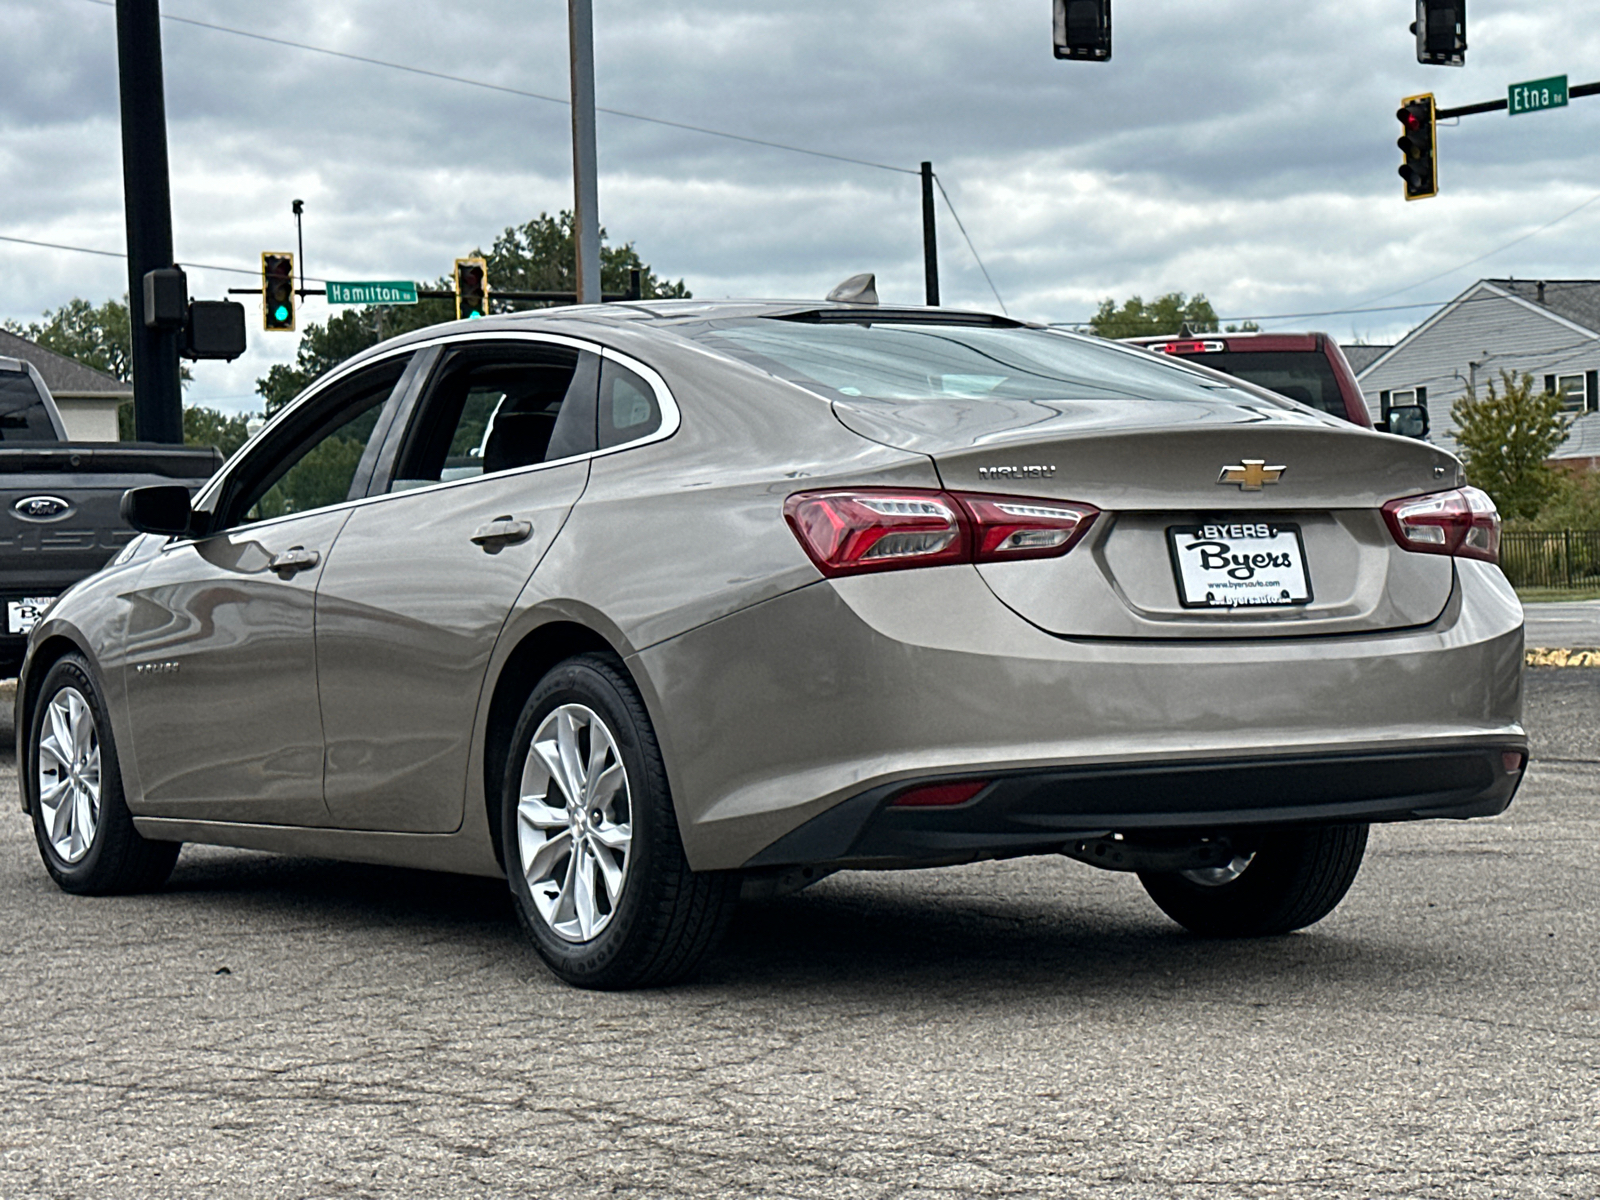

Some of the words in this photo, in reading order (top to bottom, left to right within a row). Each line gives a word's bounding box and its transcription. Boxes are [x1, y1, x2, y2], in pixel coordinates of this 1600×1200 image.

[1514, 87, 1549, 110] Etna
[332, 284, 400, 301] Hamilton
[978, 465, 1056, 480] MALIBU
[28, 500, 57, 514] Ford
[1203, 524, 1270, 538] BYERS
[1185, 541, 1292, 580] Byers
[1207, 580, 1281, 590] www.byersauto.com
